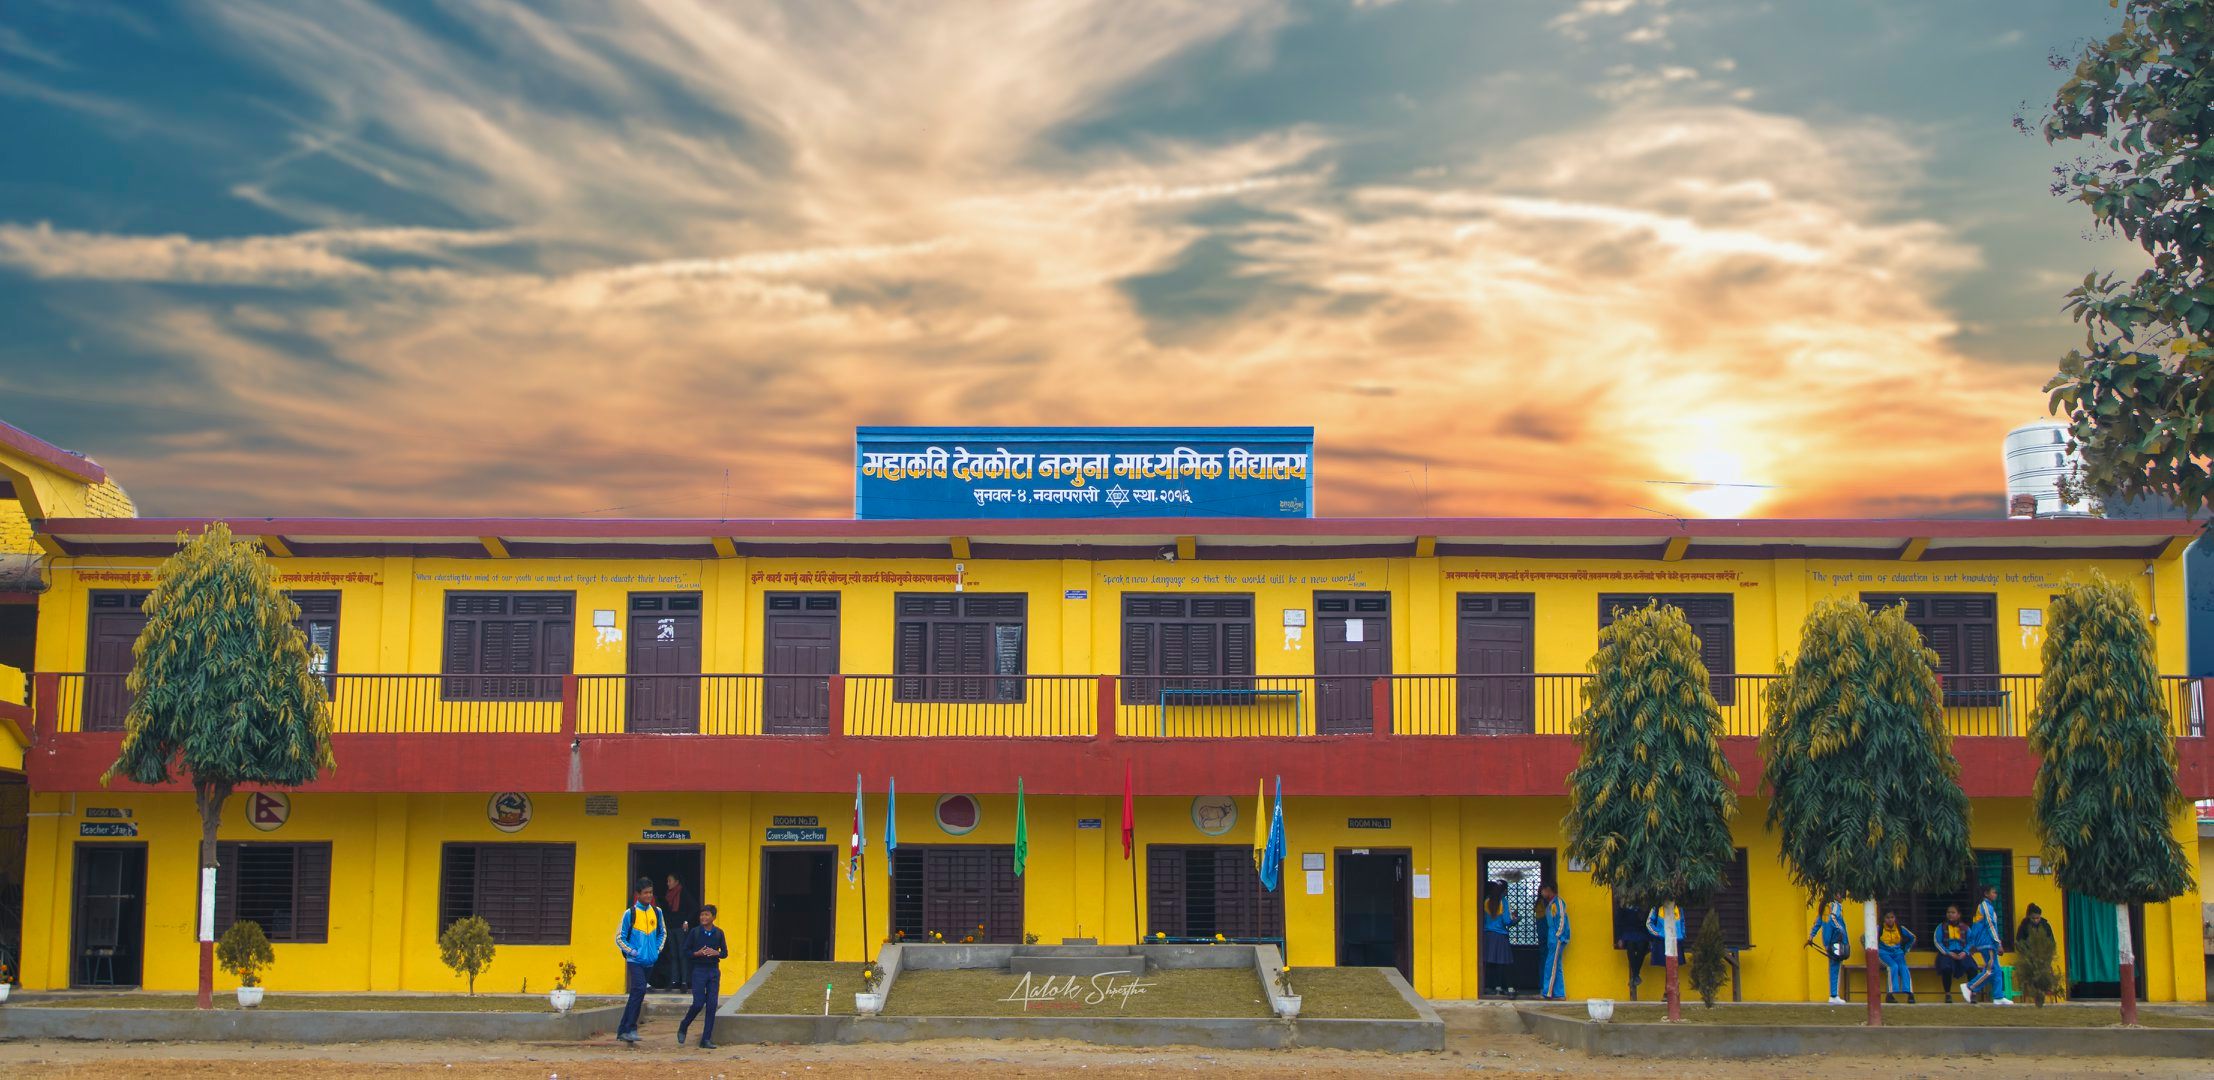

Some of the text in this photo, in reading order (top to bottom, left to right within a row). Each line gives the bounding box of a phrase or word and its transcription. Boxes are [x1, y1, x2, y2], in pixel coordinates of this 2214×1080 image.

[862, 446, 1308, 487] महाकवि देवकोटा नमुना माध्यमिक विद्यालय
[1033, 486, 1100, 504] नवलपरासी
[462, 573, 472, 582] the
[475, 573, 489, 582] mind
[492, 574, 498, 582] of
[515, 574, 531, 584] youth
[546, 574, 561, 582] must
[564, 574, 573, 583] not
[577, 574, 597, 585] forget
[601, 574, 608, 582] to
[611, 574, 635, 583] educate
[637, 574, 655, 583] their
[1203, 574, 1220, 583] that
[1224, 574, 1237, 583] the
[1241, 575, 1265, 584] world
[1270, 574, 1284, 584] will
[1289, 574, 1297, 583] be
[1832, 572, 1853, 586] great
[1858, 573, 1872, 582] aim
[1877, 574, 1887, 583] of
[1892, 573, 1928, 582] education
[1933, 573, 1939, 582] is
[1944, 574, 1958, 582] not
[1962, 574, 1999, 586] knowledge
[2006, 573, 2019, 582] but
[775, 817, 796, 825] ROOM
[81, 824, 109, 834] Teacher
[643, 831, 666, 839] Teacher
[800, 830, 824, 840] Section
